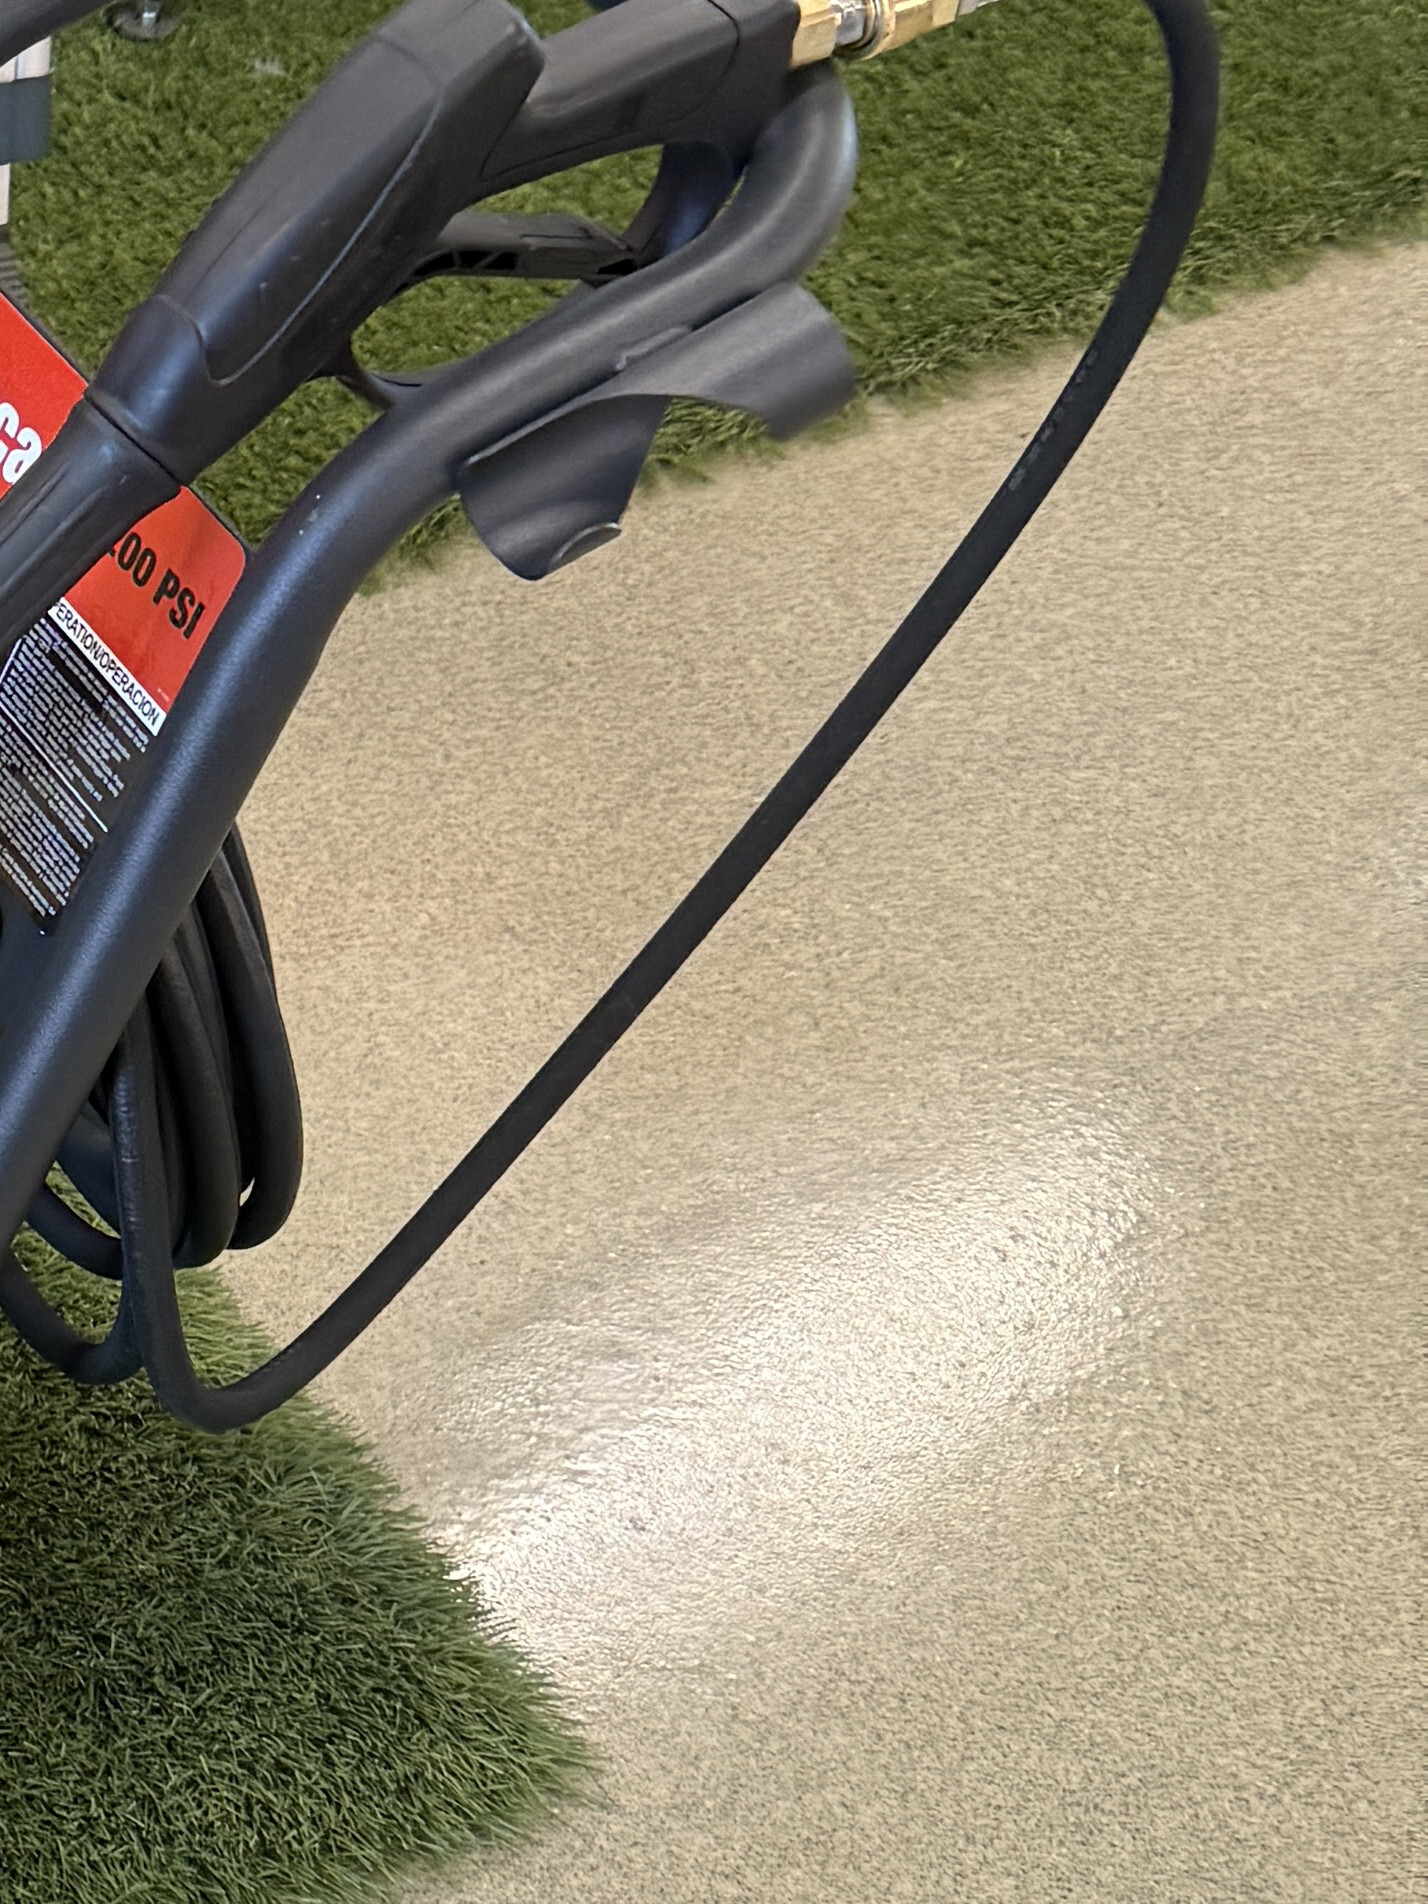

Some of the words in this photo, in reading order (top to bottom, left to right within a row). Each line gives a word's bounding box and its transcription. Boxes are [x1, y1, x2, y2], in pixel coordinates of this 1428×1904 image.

[108, 532, 156, 588] 00
[153, 568, 206, 639] PSI
[55, 602, 160, 726] ERATION/OPERACION
